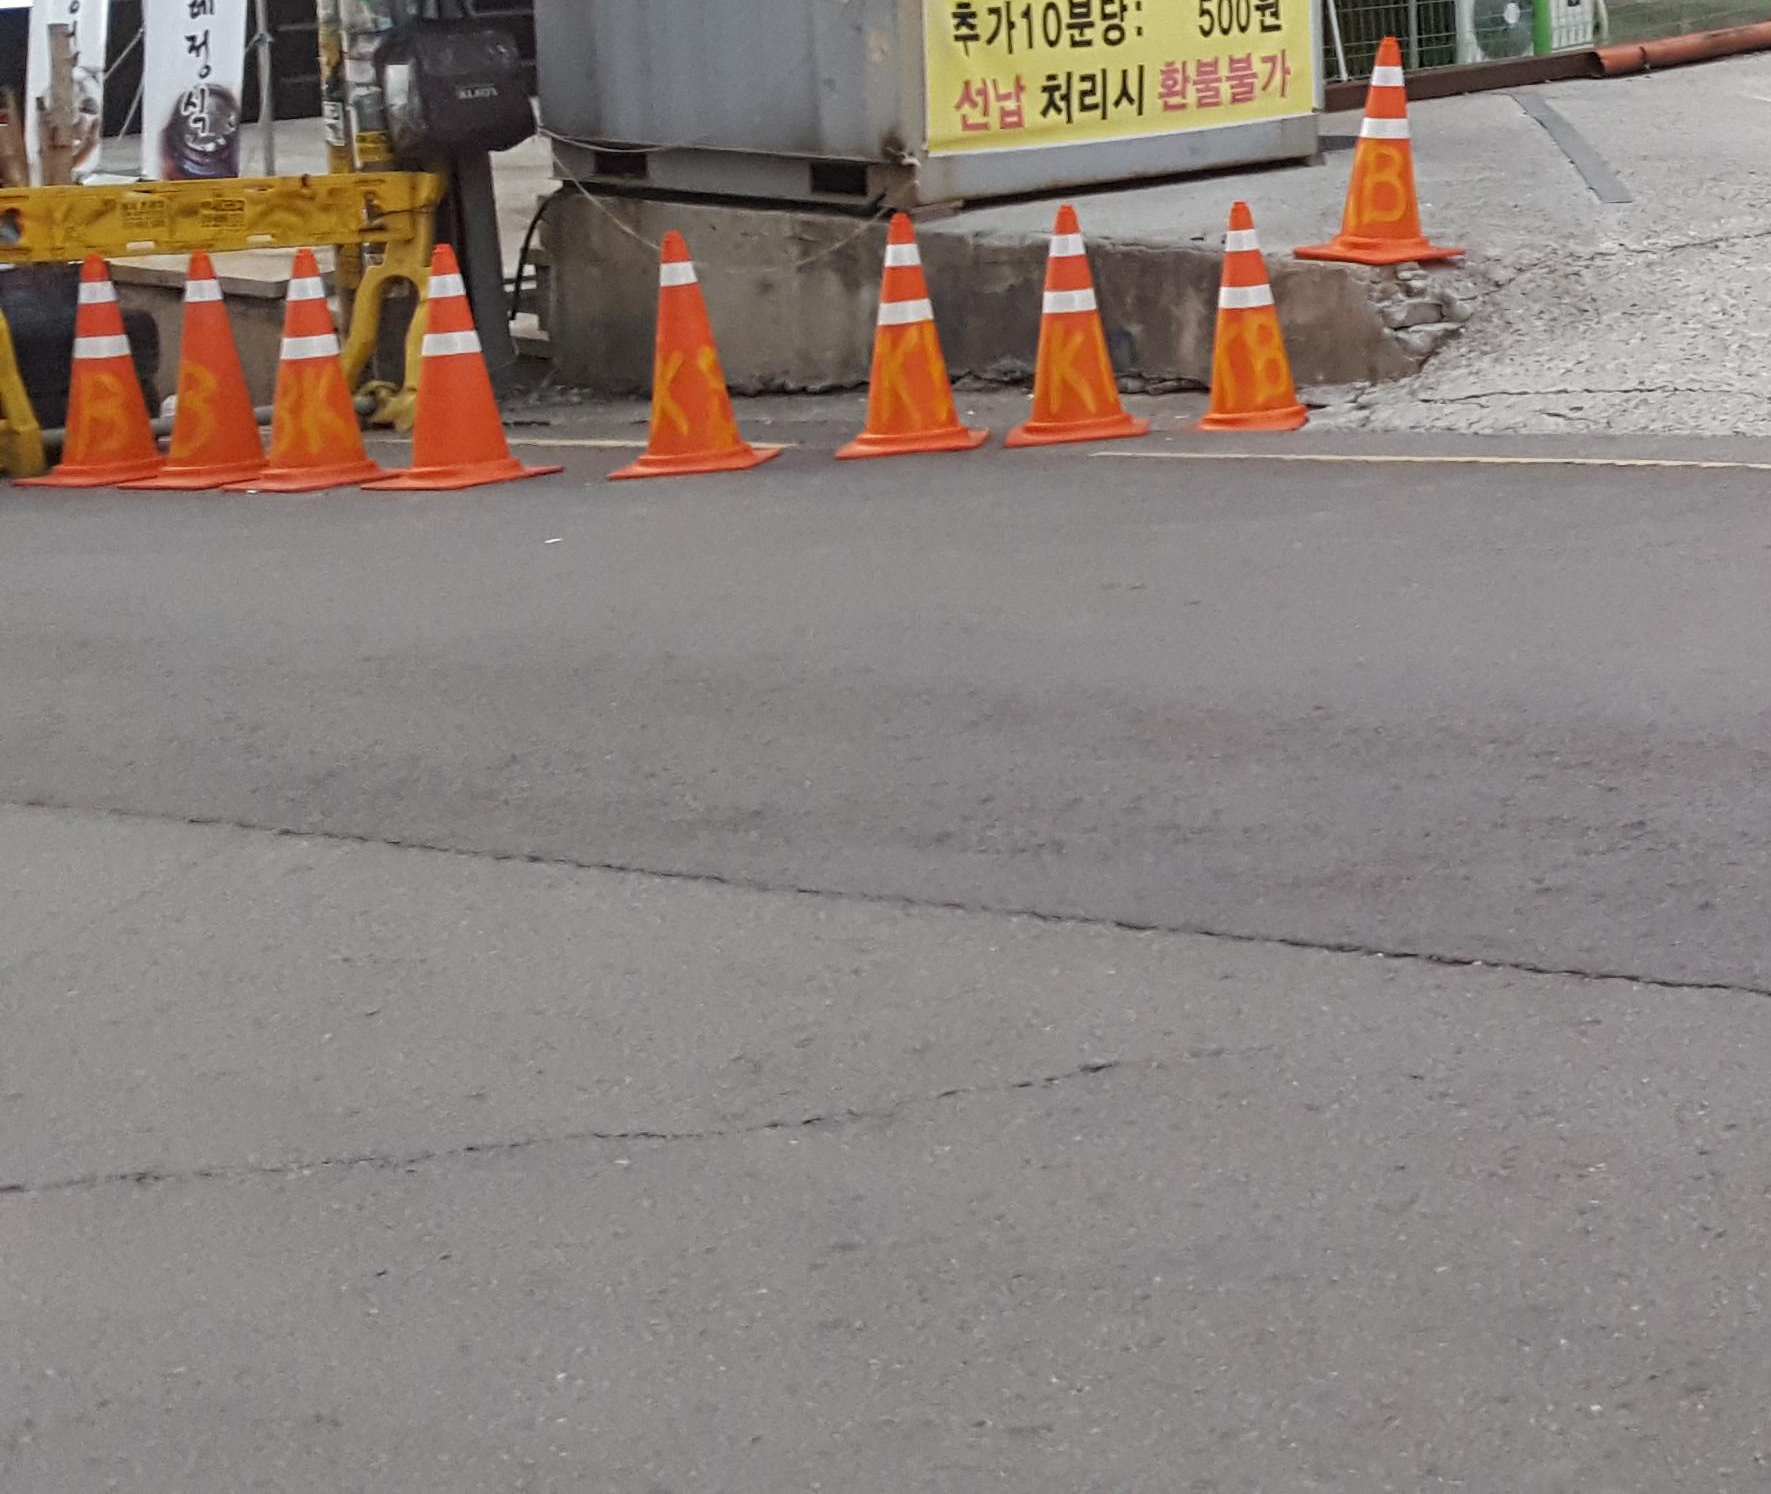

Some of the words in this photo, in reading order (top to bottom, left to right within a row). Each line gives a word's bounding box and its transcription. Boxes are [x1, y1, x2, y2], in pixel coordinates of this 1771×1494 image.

[953, 74, 1026, 133] 선납
[1039, 64, 1147, 124] 처리시
[1157, 49, 1292, 112] 환불불가
